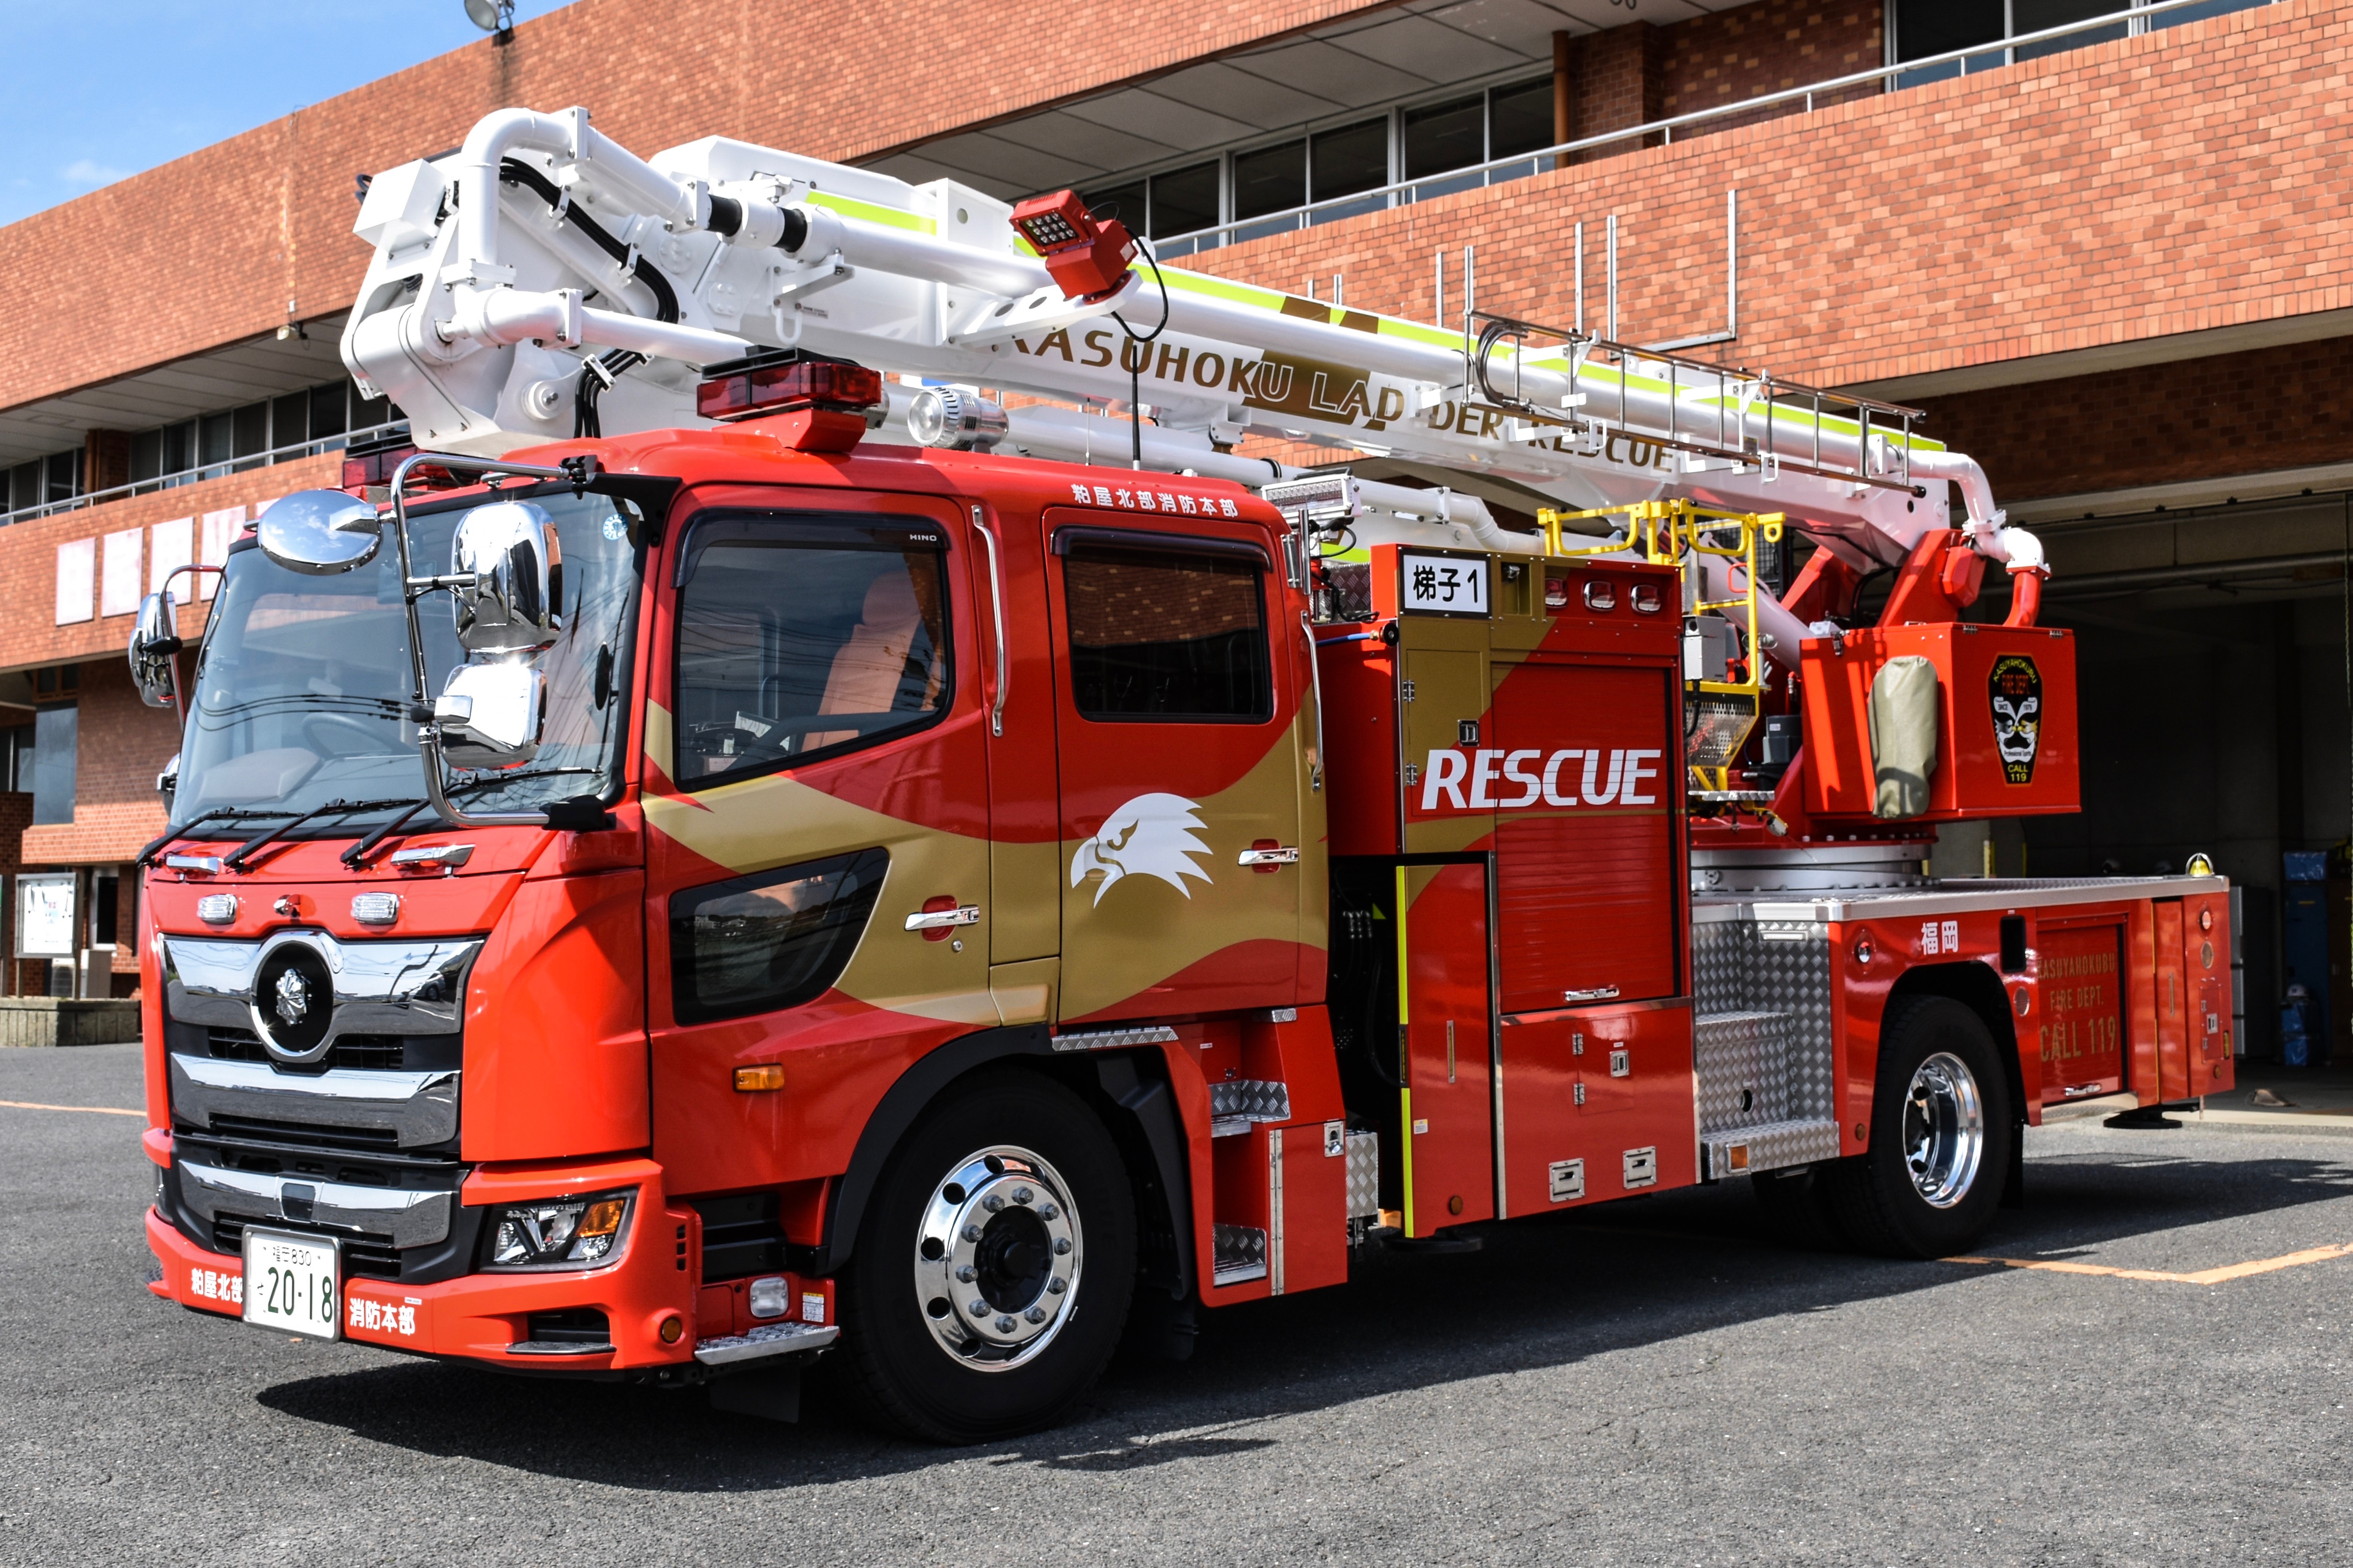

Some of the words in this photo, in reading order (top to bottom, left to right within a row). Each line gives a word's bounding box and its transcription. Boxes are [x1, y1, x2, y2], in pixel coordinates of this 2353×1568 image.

[1071, 484, 1238, 518] 粕屋北部消防本部
[1413, 565, 1478, 603] 梯子1
[1421, 749, 1661, 809] RESCUE
[2008, 764, 2028, 772] CALL
[2010, 773, 2026, 782] 119
[1921, 920, 1958, 955] 福岡
[2038, 952, 2115, 980] KASUYAHOKUBU
[2050, 988, 2073, 1011] FIRE
[2077, 986, 2104, 1008] DEPT.
[2040, 1021, 2082, 1063] CALL
[2089, 1016, 2117, 1054] 119
[191, 1267, 243, 1304] 粕屋北部
[349, 1293, 415, 1336] 消防本部
